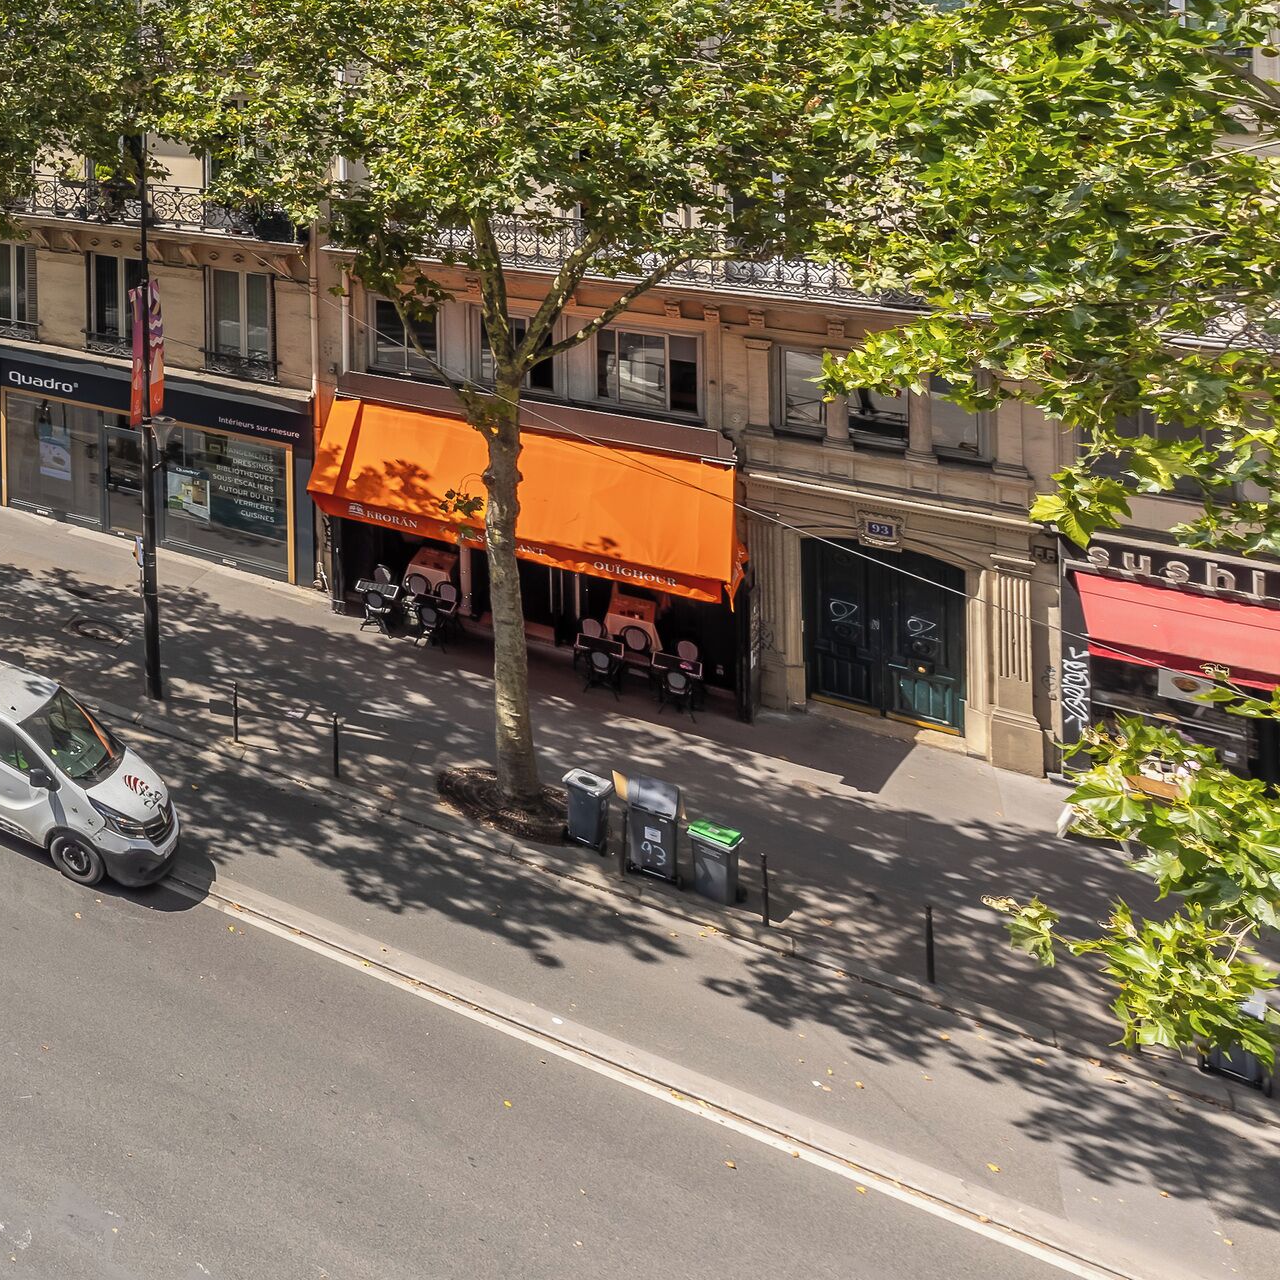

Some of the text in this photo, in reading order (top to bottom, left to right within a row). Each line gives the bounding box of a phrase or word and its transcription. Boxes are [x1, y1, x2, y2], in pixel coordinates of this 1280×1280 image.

[218, 416, 301, 439] Intérieurs sur-mesure
[216, 464, 274, 483] BIBLIOTHEQUES
[232, 458, 274, 473] DRESSINGS
[218, 484, 274, 503] AUTOUR DU LIT
[233, 498, 275, 513] VERRIERES
[240, 509, 275, 524] CUISINES
[366, 510, 418, 529] KRORÄN
[871, 524, 890, 535] 93
